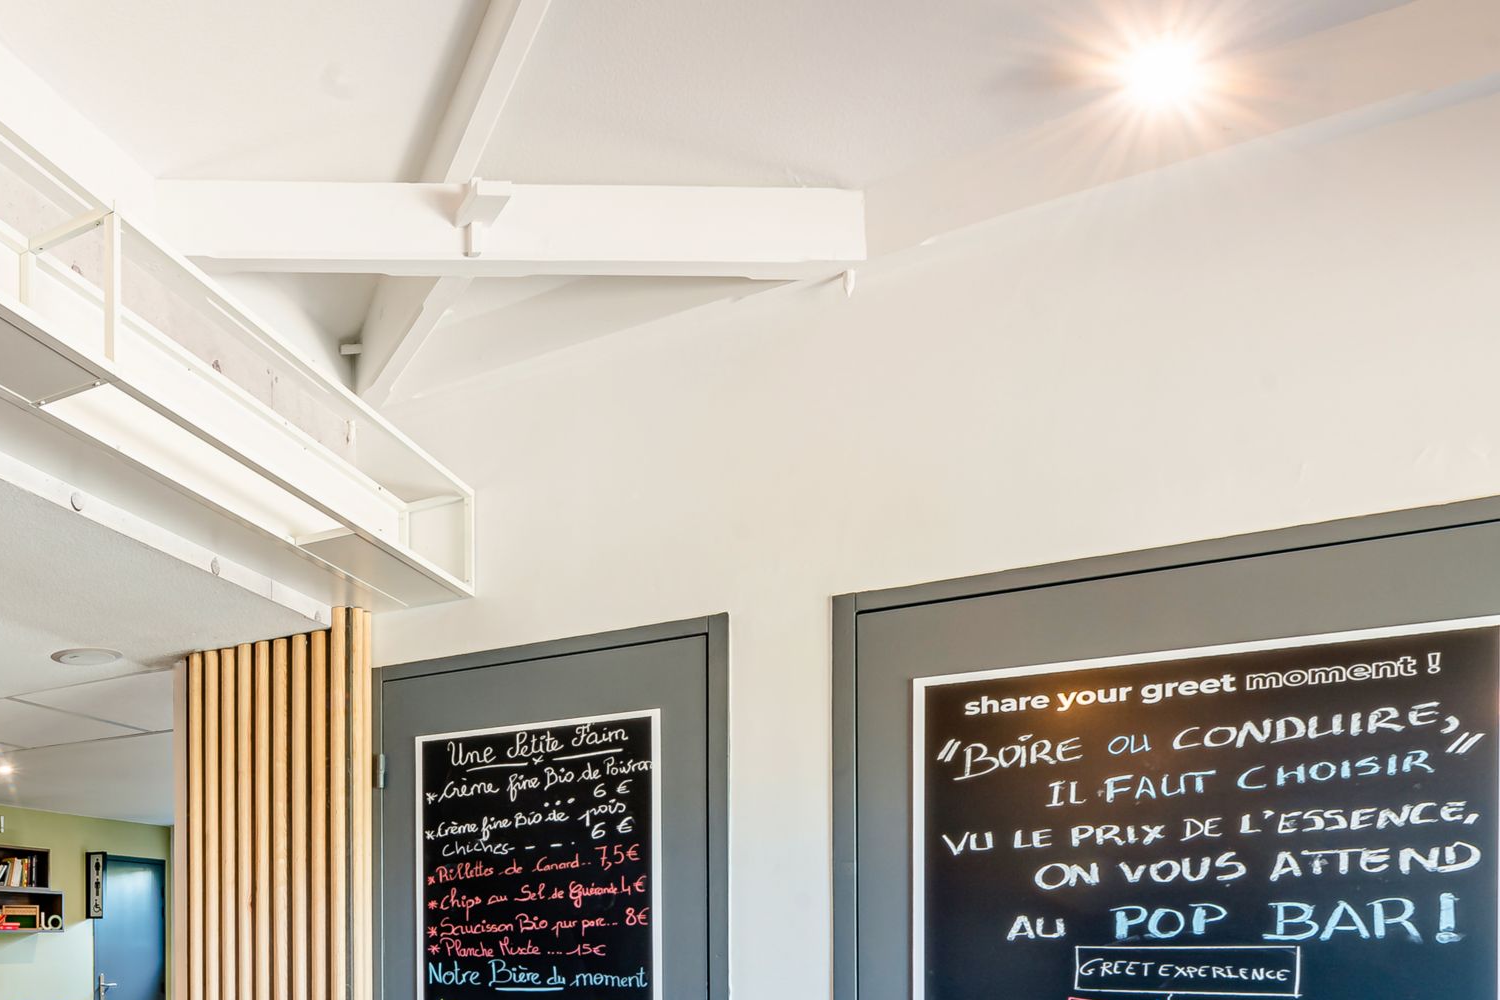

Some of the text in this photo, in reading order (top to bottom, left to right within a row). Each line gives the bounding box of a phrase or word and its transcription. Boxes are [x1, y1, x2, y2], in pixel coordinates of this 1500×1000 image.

[963, 651, 1442, 716] share your greet moment !
[446, 722, 629, 766] Une Petite Faim
[1107, 733, 1153, 755] OU
[437, 777, 501, 803] Crème
[506, 772, 541, 802] fine
[543, 766, 576, 791] Bio
[576, 761, 602, 783] de
[593, 783, 607, 798] 6
[1044, 779, 1088, 807] IL
[1102, 769, 1217, 803] FAUT
[435, 798, 627, 841] Crème fine Bio de pois
[591, 822, 606, 840] 6
[941, 831, 994, 856] VU
[1013, 829, 1053, 849] LE
[1070, 824, 1166, 848] PRIX
[1180, 817, 1223, 842] DE
[435, 859, 495, 885] Rillettes
[498, 858, 524, 876] de
[532, 852, 581, 873] Canard
[1034, 841, 1482, 891] ON VOUS ATTEND
[439, 887, 482, 922] Chips
[486, 893, 509, 907] au
[513, 882, 545, 903] Sel
[548, 884, 564, 900] de
[439, 914, 515, 938] Saucisson
[515, 912, 549, 933] Bio
[550, 917, 578, 938] pur
[1005, 914, 1067, 942] AU
[1109, 902, 1229, 941] POP
[438, 937, 495, 959] Planche
[498, 937, 542, 956] Mixte
[428, 958, 649, 988] Notre Bière du moment
[1078, 957, 1293, 984] GREET EXPERIENCE
